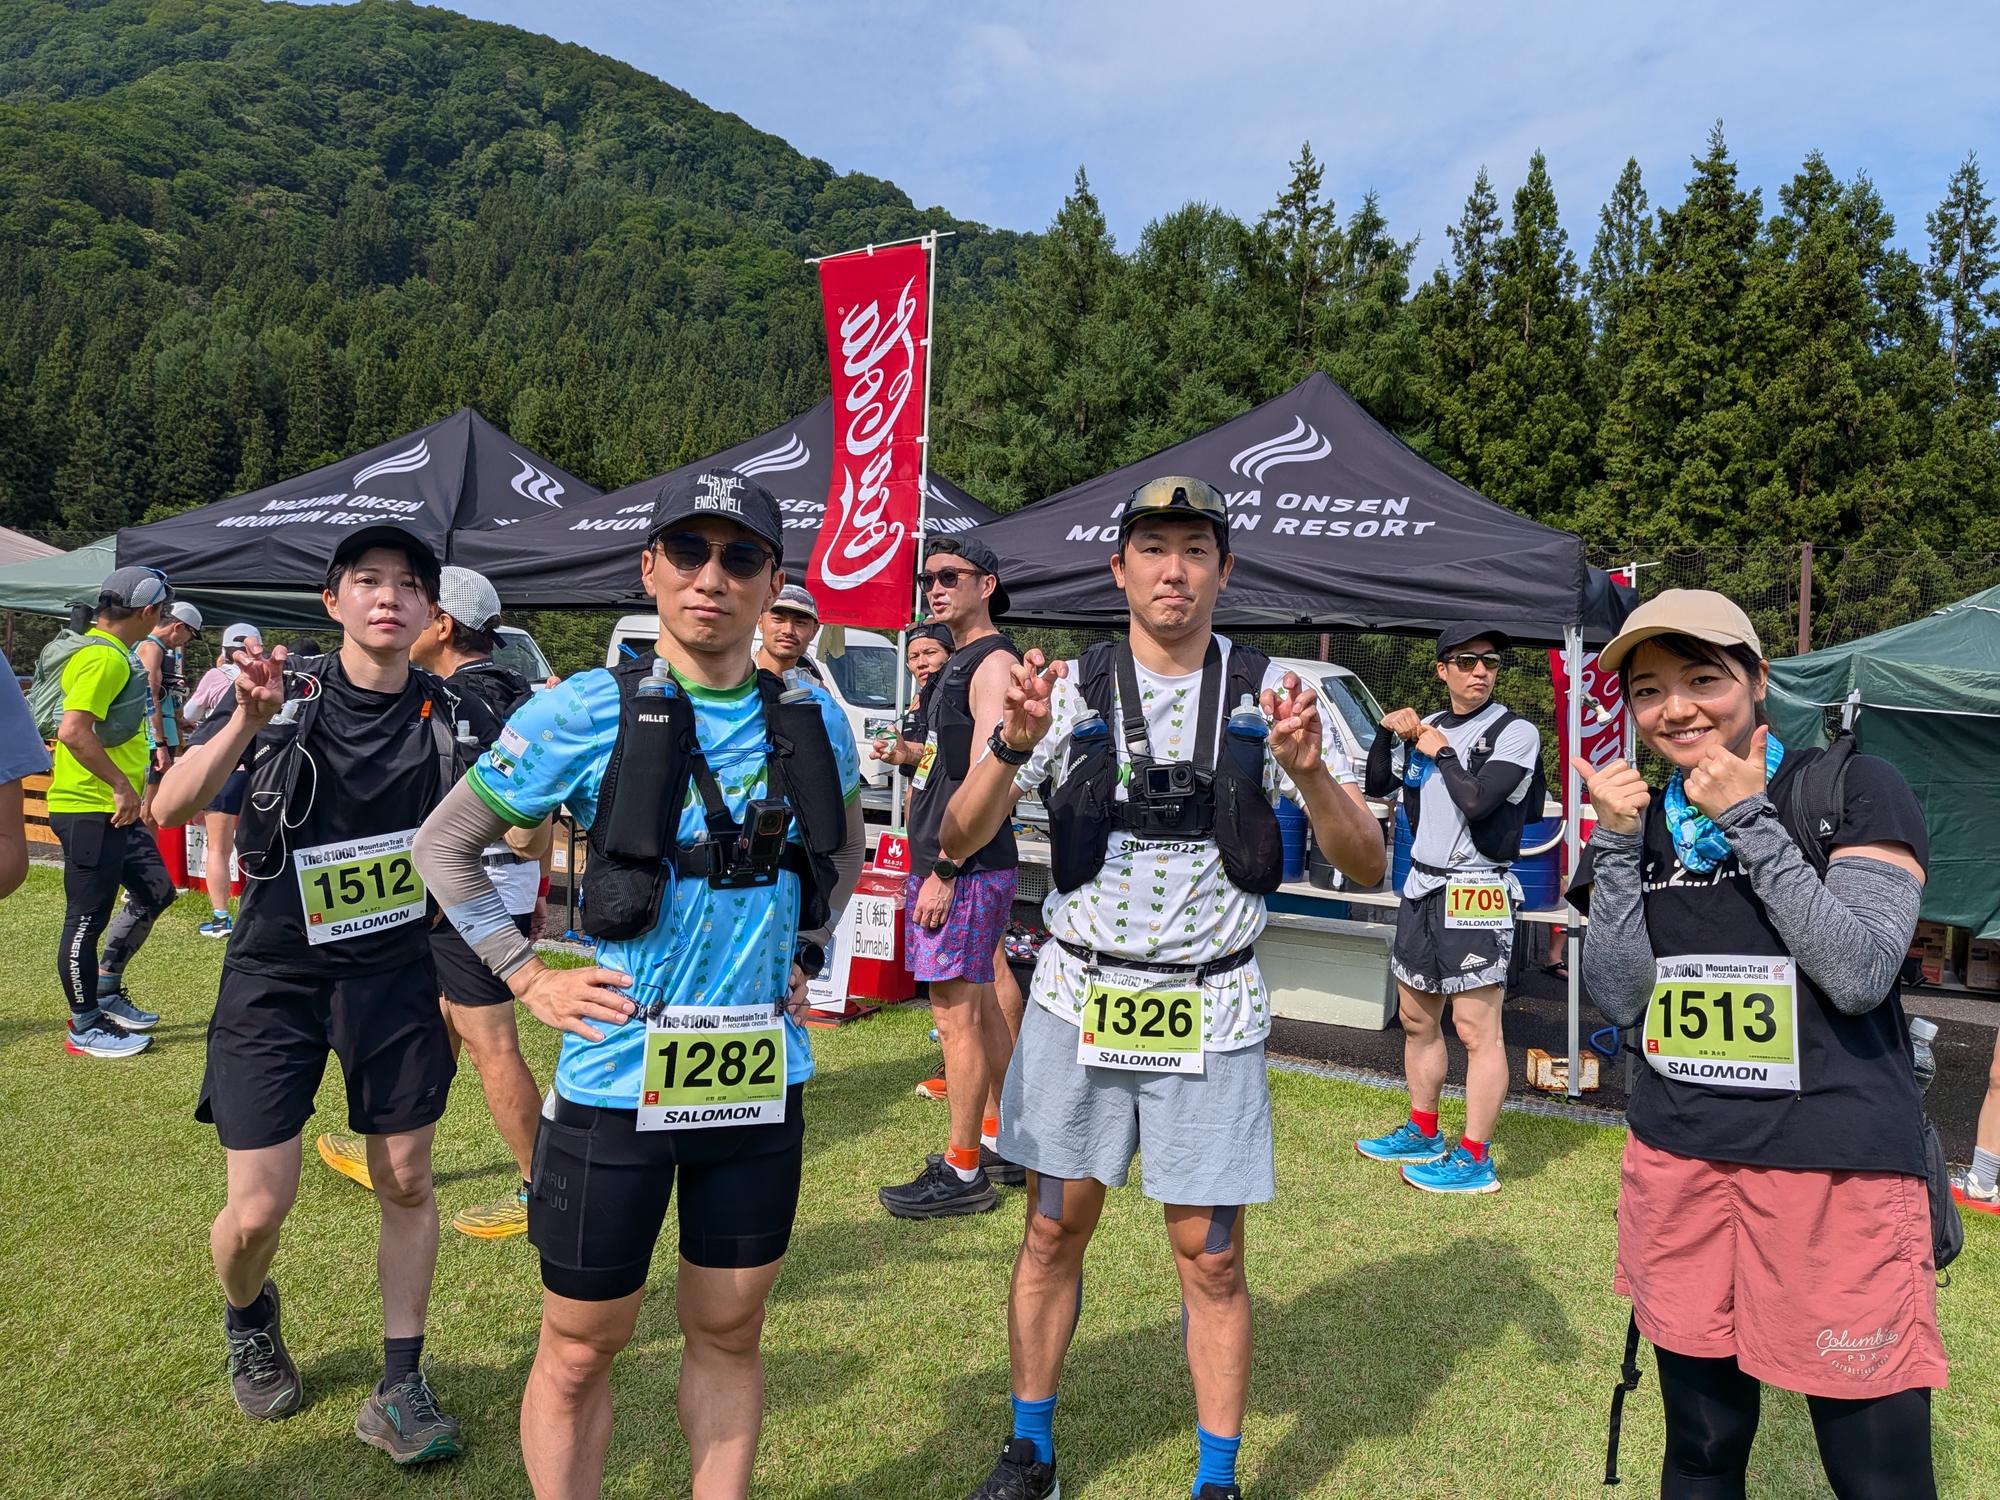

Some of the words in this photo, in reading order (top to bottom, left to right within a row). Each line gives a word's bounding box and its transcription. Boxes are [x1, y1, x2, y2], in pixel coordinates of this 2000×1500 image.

[697, 474, 720, 485] ALL'S
[721, 477, 745, 490] WELL
[708, 482, 733, 498] THAT
[260, 493, 348, 513] NOZAWA
[346, 494, 425, 513] ONSEN
[694, 496, 719, 510] ENDS
[720, 497, 744, 515] WELL
[1275, 496, 1410, 516] ONSEN
[216, 510, 328, 528] MOUNTAIN
[1272, 519, 1436, 538] RESORT
[638, 714, 670, 723] MILLET
[301, 853, 323, 866] The
[358, 840, 389, 852] Mountain
[389, 837, 404, 846] Trail
[314, 858, 414, 910] 1512
[1452, 889, 1504, 911] 1709
[331, 909, 410, 936] SALOMON
[70, 922, 89, 958] UNDER
[1660, 965, 1674, 978] The
[1705, 964, 1747, 973] Mountain
[1748, 965, 1769, 973] Trail
[69, 959, 85, 1004] ARMOUR
[723, 1014, 753, 1023] Mountain
[754, 1012, 768, 1020] Trail
[1094, 993, 1193, 1037] 1326
[1658, 990, 1777, 1043] 1513
[659, 1038, 775, 1089] 1282
[1099, 1051, 1181, 1067] SALOMON
[1668, 1062, 1768, 1081] SALOMON
[664, 1106, 761, 1124] SALOMON
